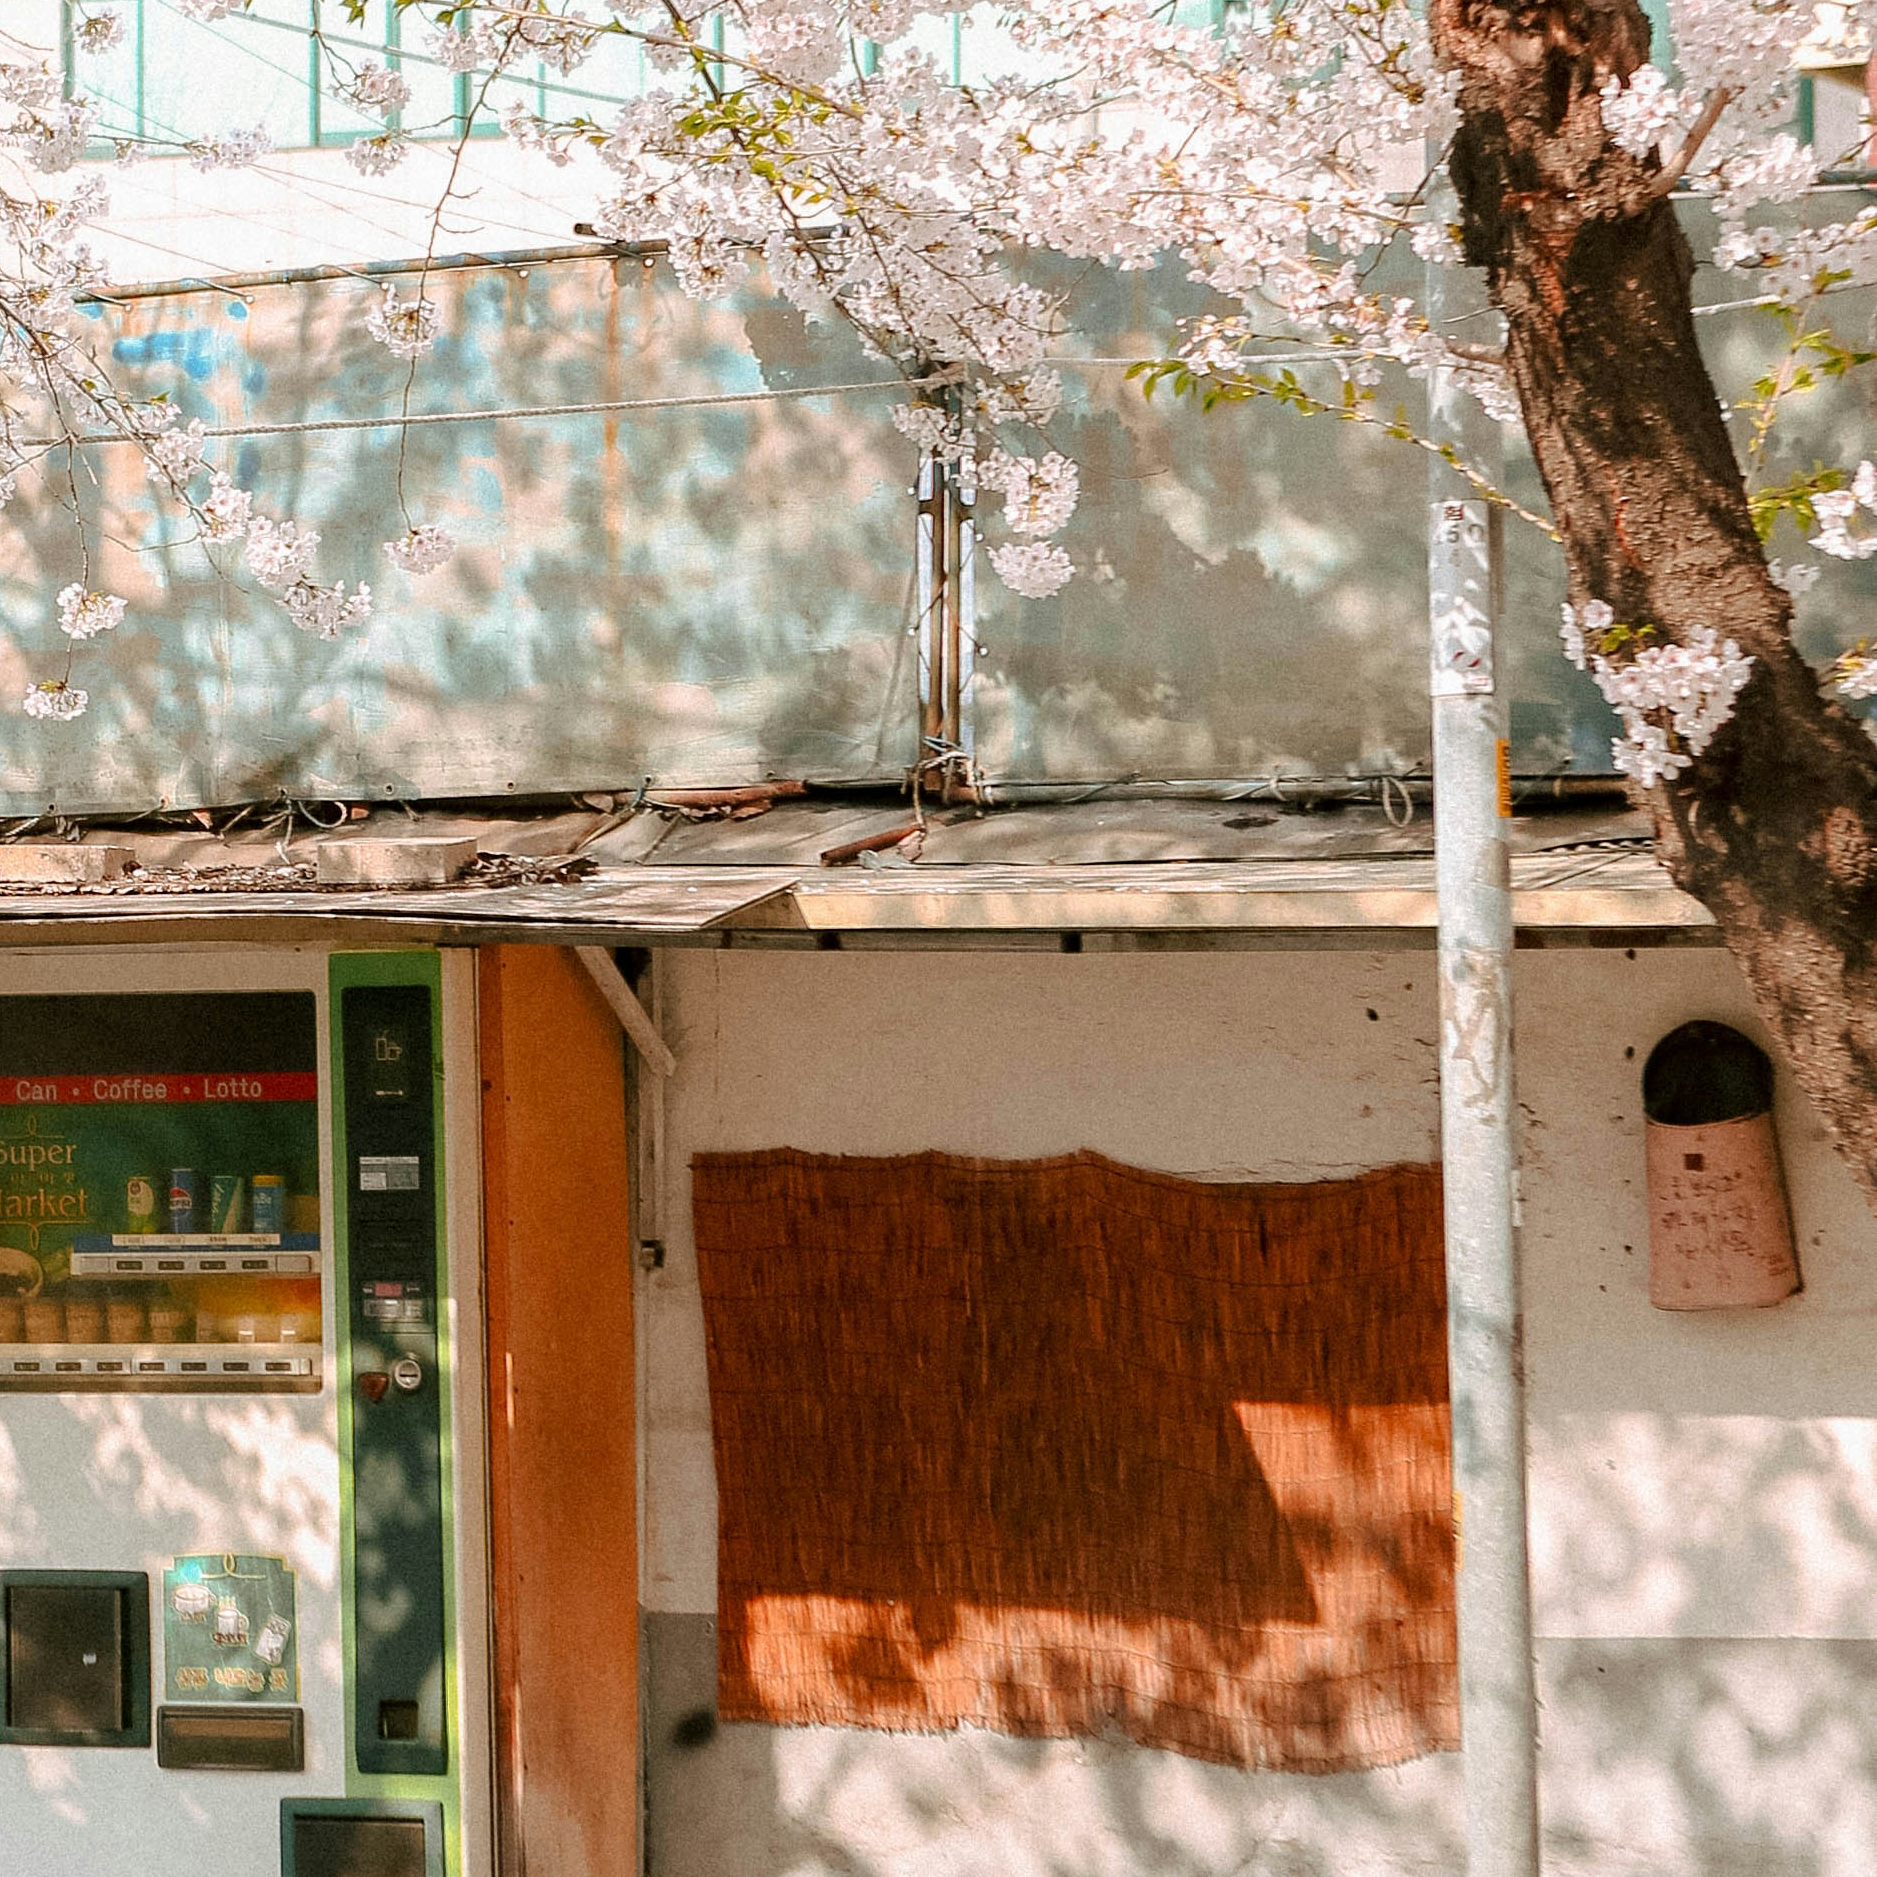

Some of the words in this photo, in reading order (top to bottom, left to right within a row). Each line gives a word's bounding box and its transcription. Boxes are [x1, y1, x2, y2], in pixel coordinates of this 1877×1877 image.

[15, 1080, 58, 1101] Can
[93, 1078, 168, 1100] Coffee
[203, 1078, 263, 1099] Lotto
